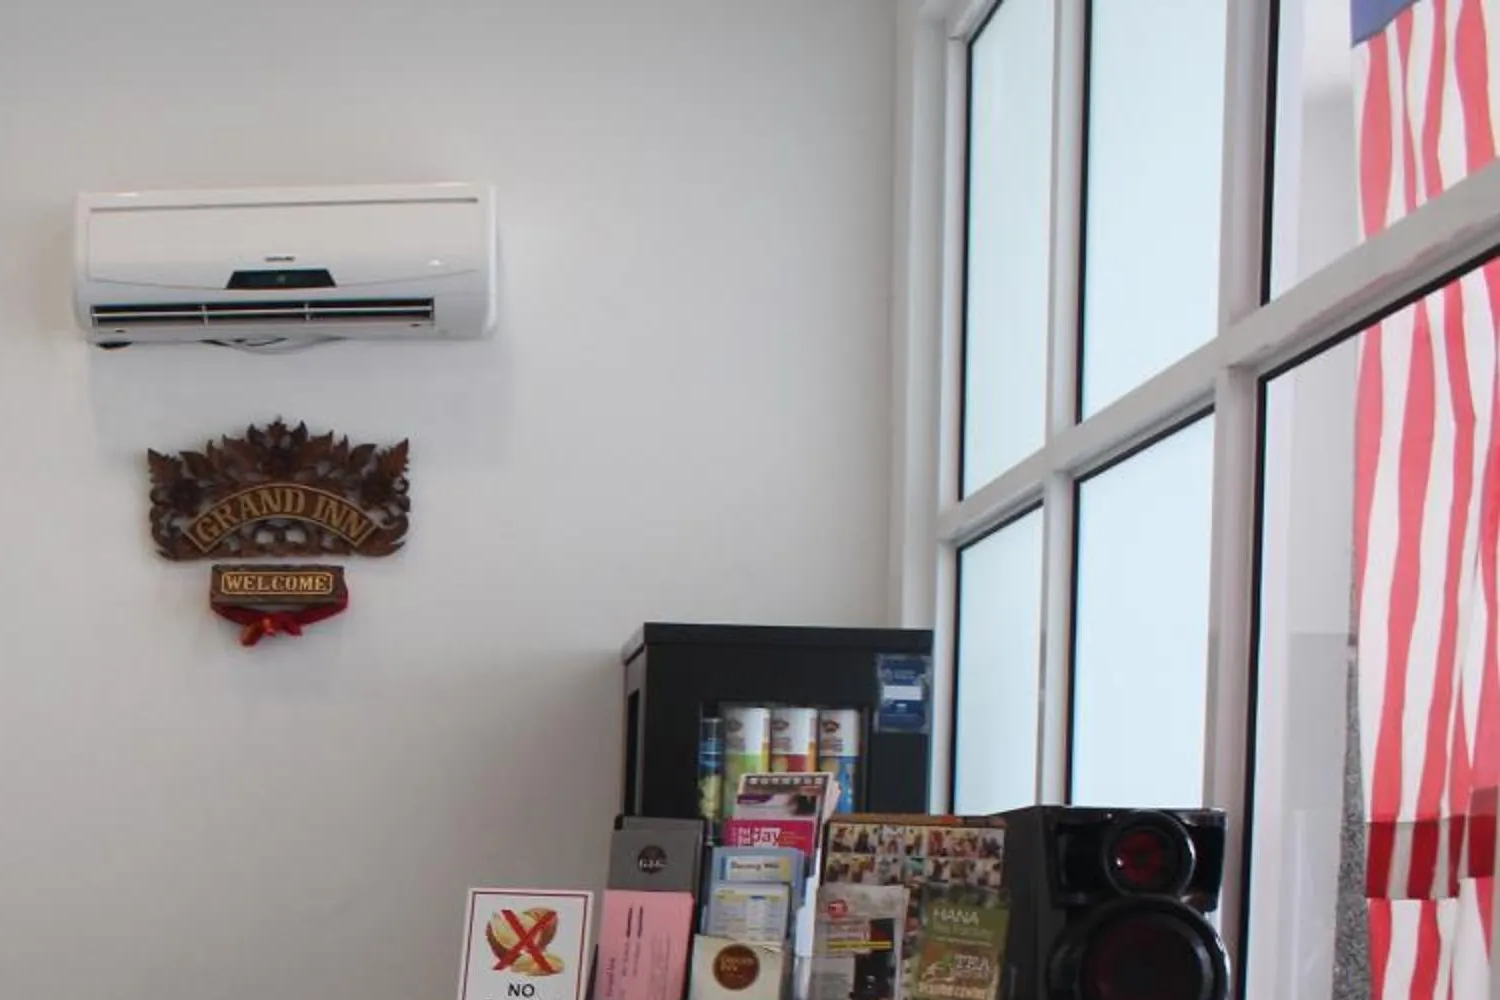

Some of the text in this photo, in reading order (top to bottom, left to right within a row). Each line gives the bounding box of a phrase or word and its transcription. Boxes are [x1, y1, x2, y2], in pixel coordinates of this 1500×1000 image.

[195, 487, 369, 542] GRAND INN
[224, 574, 329, 592] WELCOME
[933, 907, 980, 926] HANA
[507, 983, 535, 998] NO
